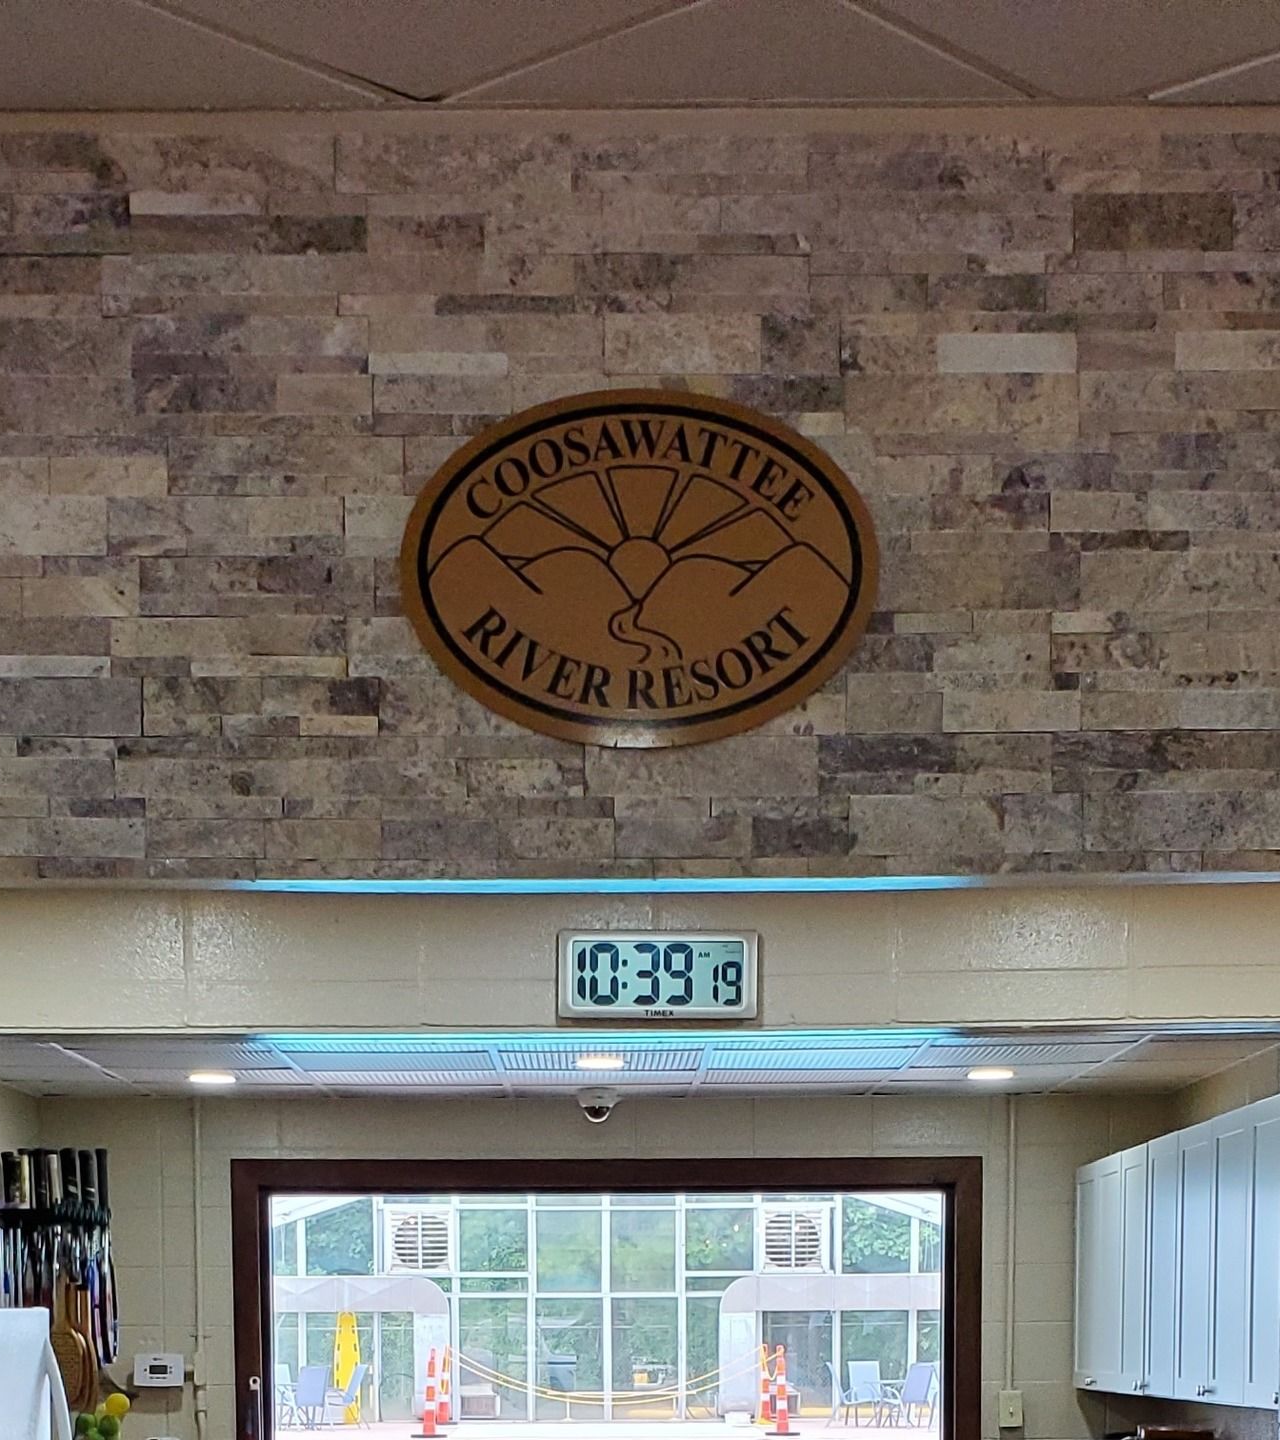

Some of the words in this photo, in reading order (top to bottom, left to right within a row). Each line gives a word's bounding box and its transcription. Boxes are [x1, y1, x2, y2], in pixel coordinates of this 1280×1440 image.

[465, 418, 816, 524] COOSAWATTEE
[461, 605, 612, 710] RIVER
[625, 604, 811, 710] RESORT
[577, 942, 694, 1006] 10:39
[697, 951, 711, 959] AM
[712, 960, 742, 1006] 19
[643, 1009, 675, 1017] TIMEX
